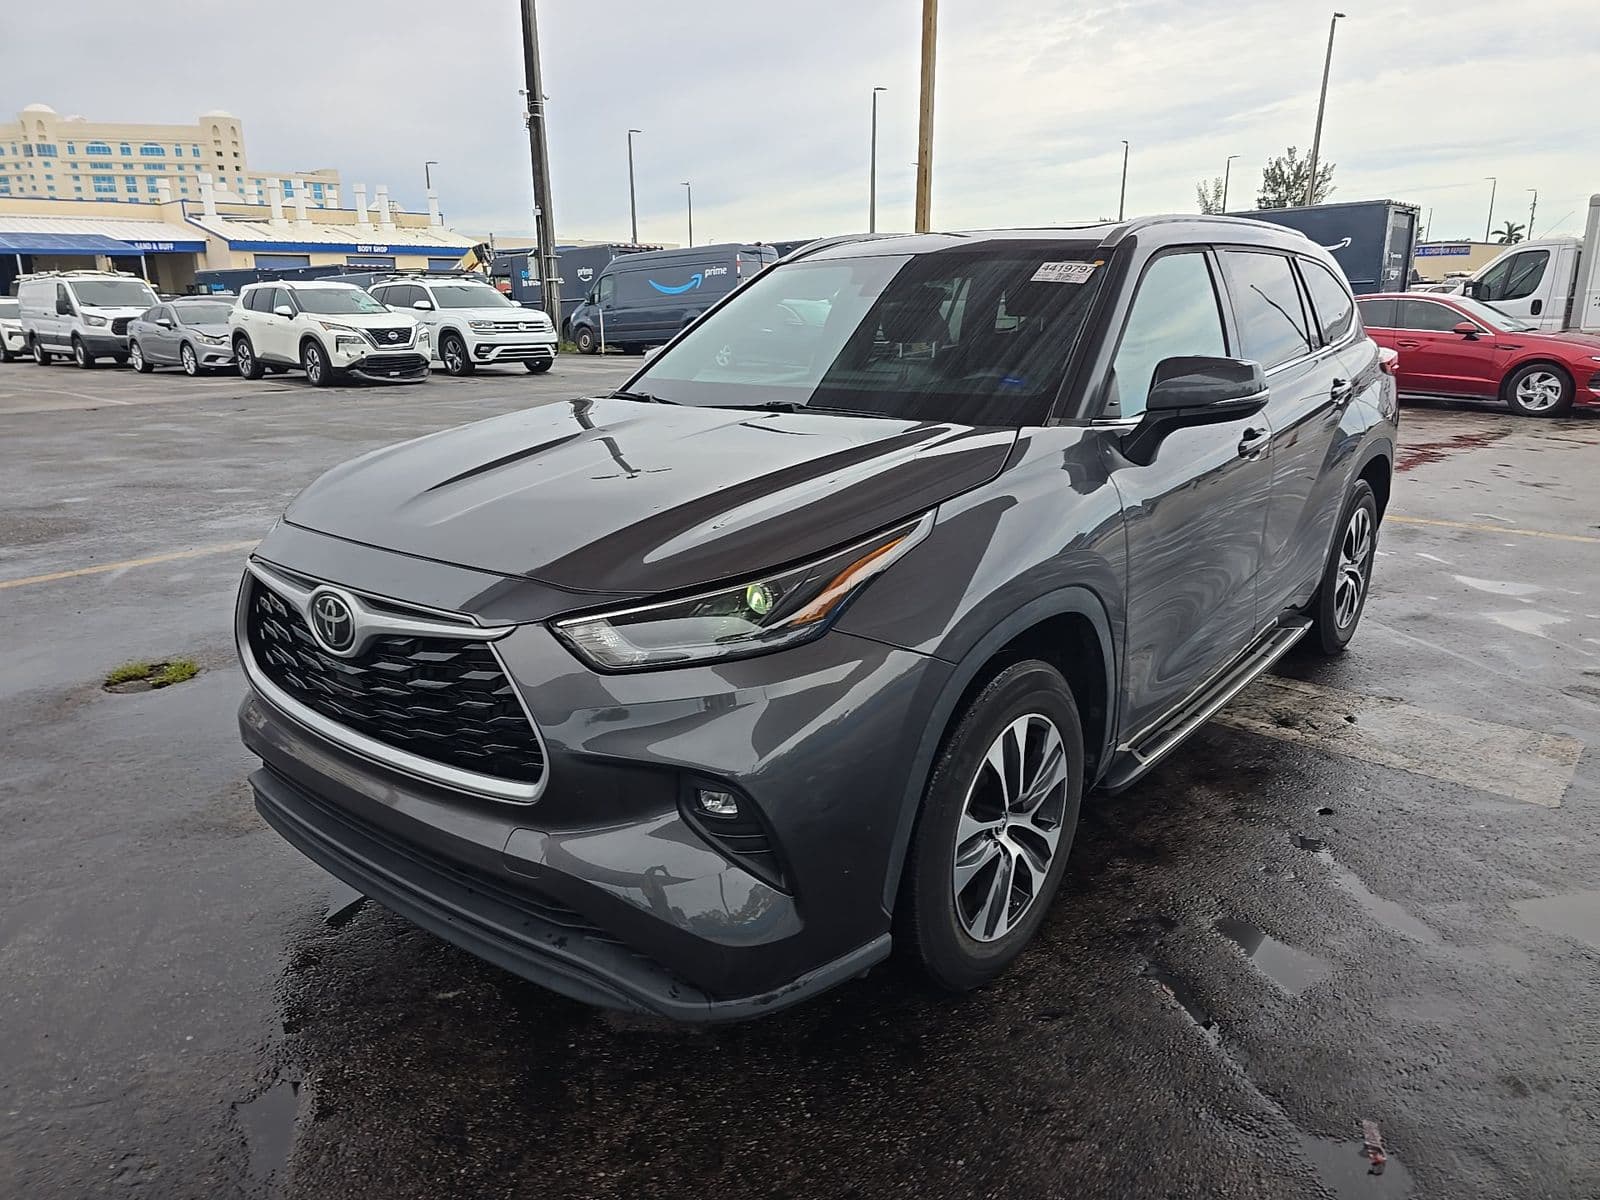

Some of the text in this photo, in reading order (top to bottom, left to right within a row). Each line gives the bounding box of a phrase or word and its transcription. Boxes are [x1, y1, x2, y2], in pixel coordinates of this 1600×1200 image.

[357, 245, 388, 253] BODY SHOP
[577, 266, 593, 278] prime
[704, 266, 727, 278] prime
[1042, 263, 1094, 274] 4419797
